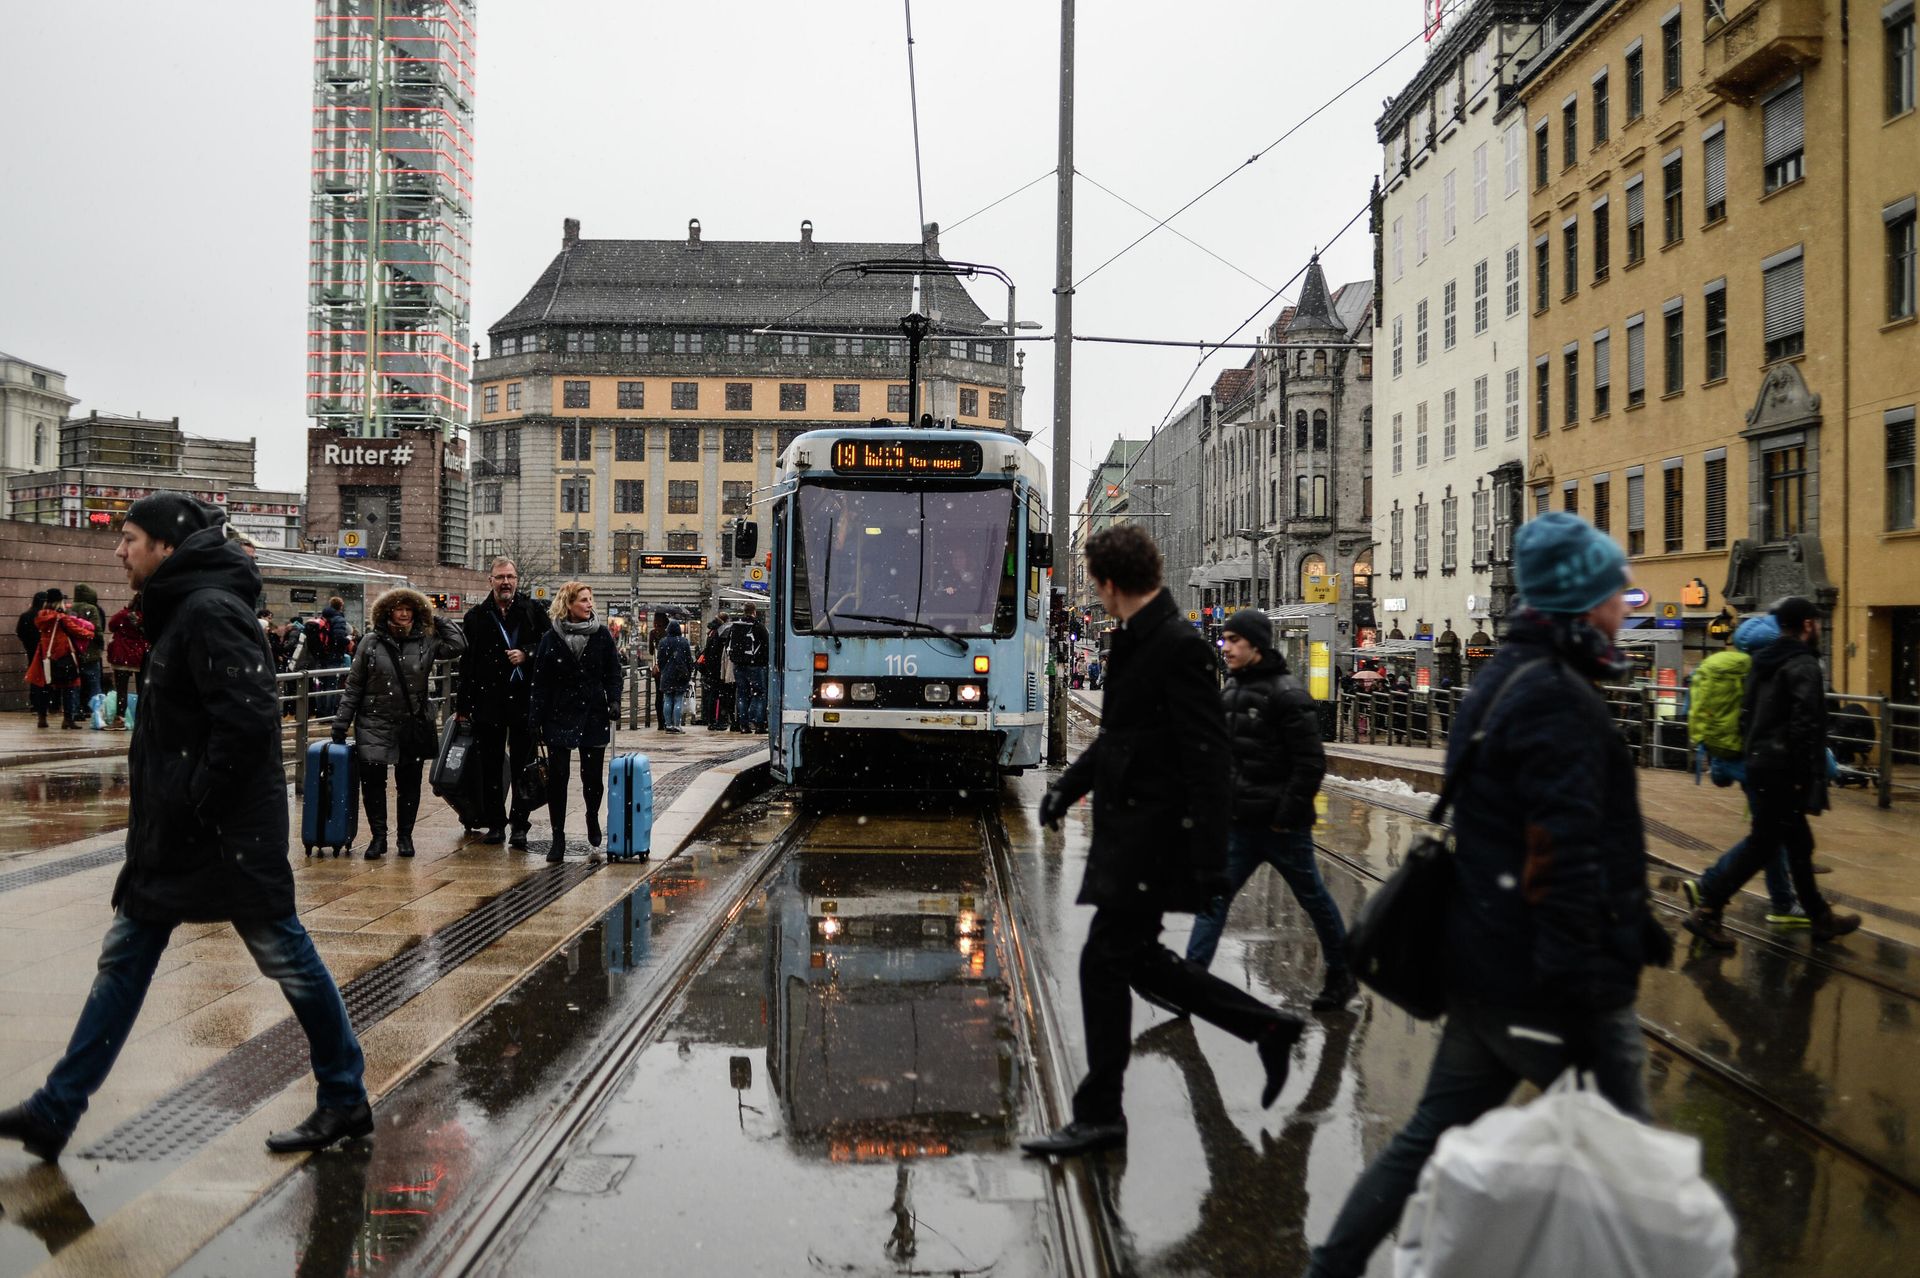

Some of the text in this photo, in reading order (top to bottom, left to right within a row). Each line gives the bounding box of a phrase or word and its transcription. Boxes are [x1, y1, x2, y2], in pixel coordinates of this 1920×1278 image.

[324, 444, 414, 465] Ruter#
[90, 513, 111, 524] OPEN
[348, 534, 356, 544] D
[753, 569, 760, 579] C
[885, 654, 918, 676] 116
